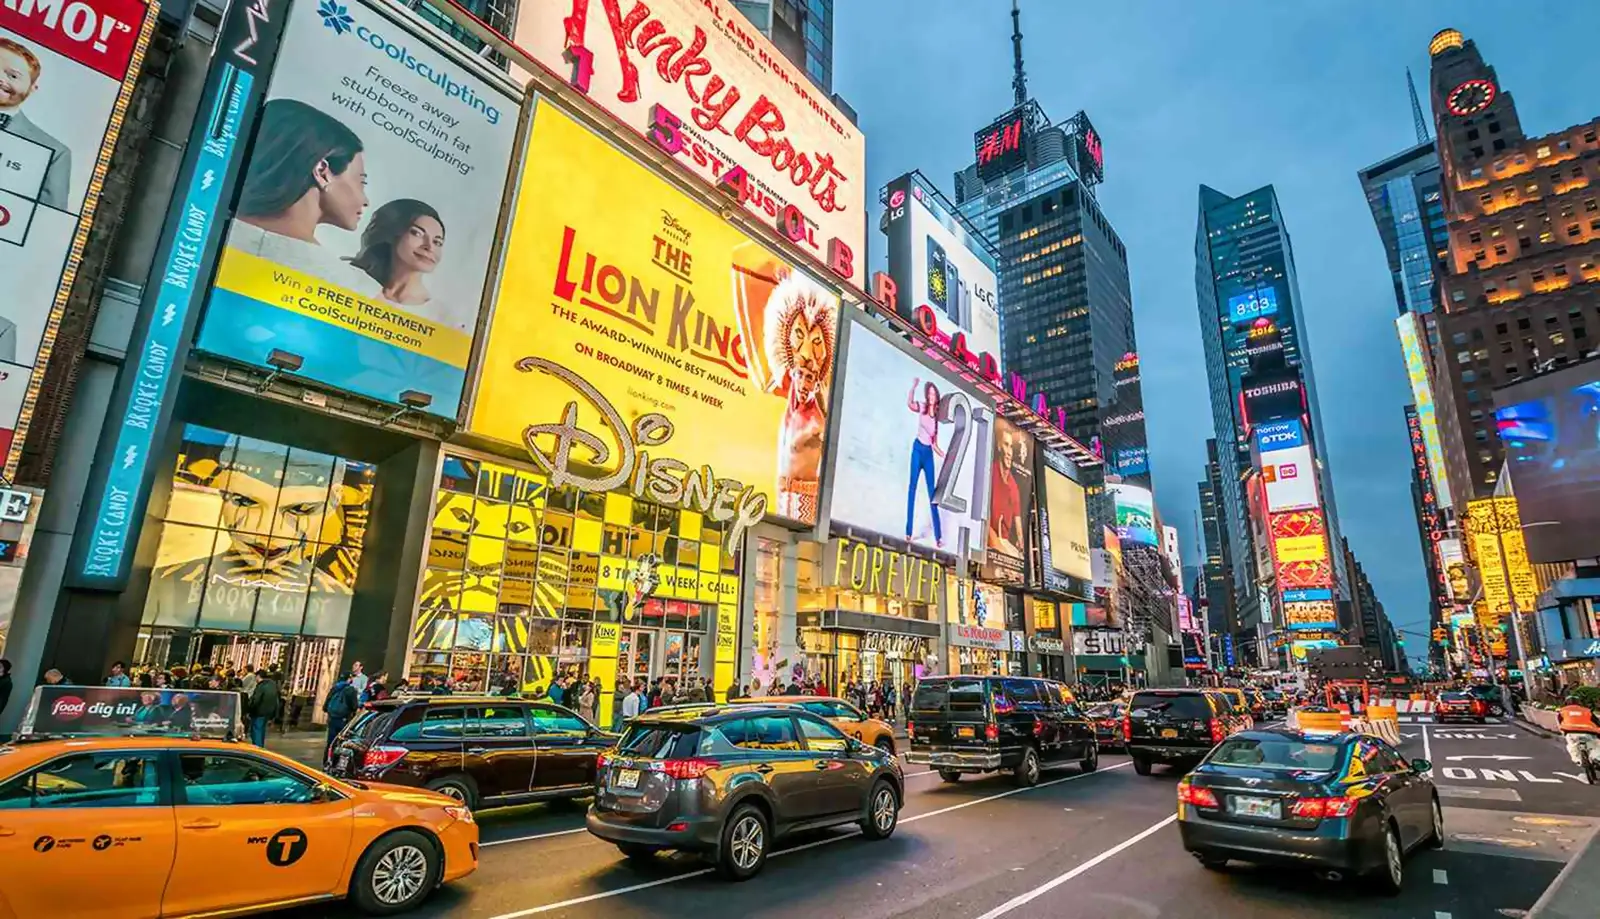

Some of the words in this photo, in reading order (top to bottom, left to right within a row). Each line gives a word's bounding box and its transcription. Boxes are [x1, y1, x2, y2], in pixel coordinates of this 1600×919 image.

[727, 19, 756, 50] AND
[331, 91, 366, 118] with
[357, 26, 501, 125] coolsculpting
[365, 65, 418, 104] Freeze
[422, 101, 460, 128] away
[341, 75, 414, 123] stubborn
[419, 118, 449, 143] chin
[454, 135, 472, 155] fat
[734, 94, 847, 212] Boots
[164, 243, 200, 289] BROOKE
[185, 203, 208, 244] CANDY
[652, 234, 693, 277] THE
[273, 271, 301, 291] Win
[304, 286, 313, 295] a
[317, 287, 354, 308] FREE
[357, 300, 436, 338] TREATMENT
[281, 293, 294, 304] at
[298, 297, 423, 348] CoolSculpting.com
[551, 303, 577, 324] THE
[580, 315, 682, 369] AWARD-WINNING
[684, 361, 706, 379] BEST
[707, 373, 747, 397] MUSICAL
[574, 342, 593, 357] ON
[597, 350, 655, 382] BROADWAY
[656, 374, 663, 385] 8
[665, 378, 690, 397] TIMES
[692, 388, 699, 399] A
[700, 391, 724, 410] WEEK
[126, 381, 163, 430] BROOKE
[148, 340, 169, 380] CANDY
[1245, 380, 1299, 398] TOSHIBA
[1270, 431, 1297, 442] TDK
[104, 485, 130, 529] CANDY
[834, 538, 941, 604] FOREVER
[87, 702, 113, 718] dig
[115, 702, 137, 716] in!
[248, 836, 268, 845] NYC
